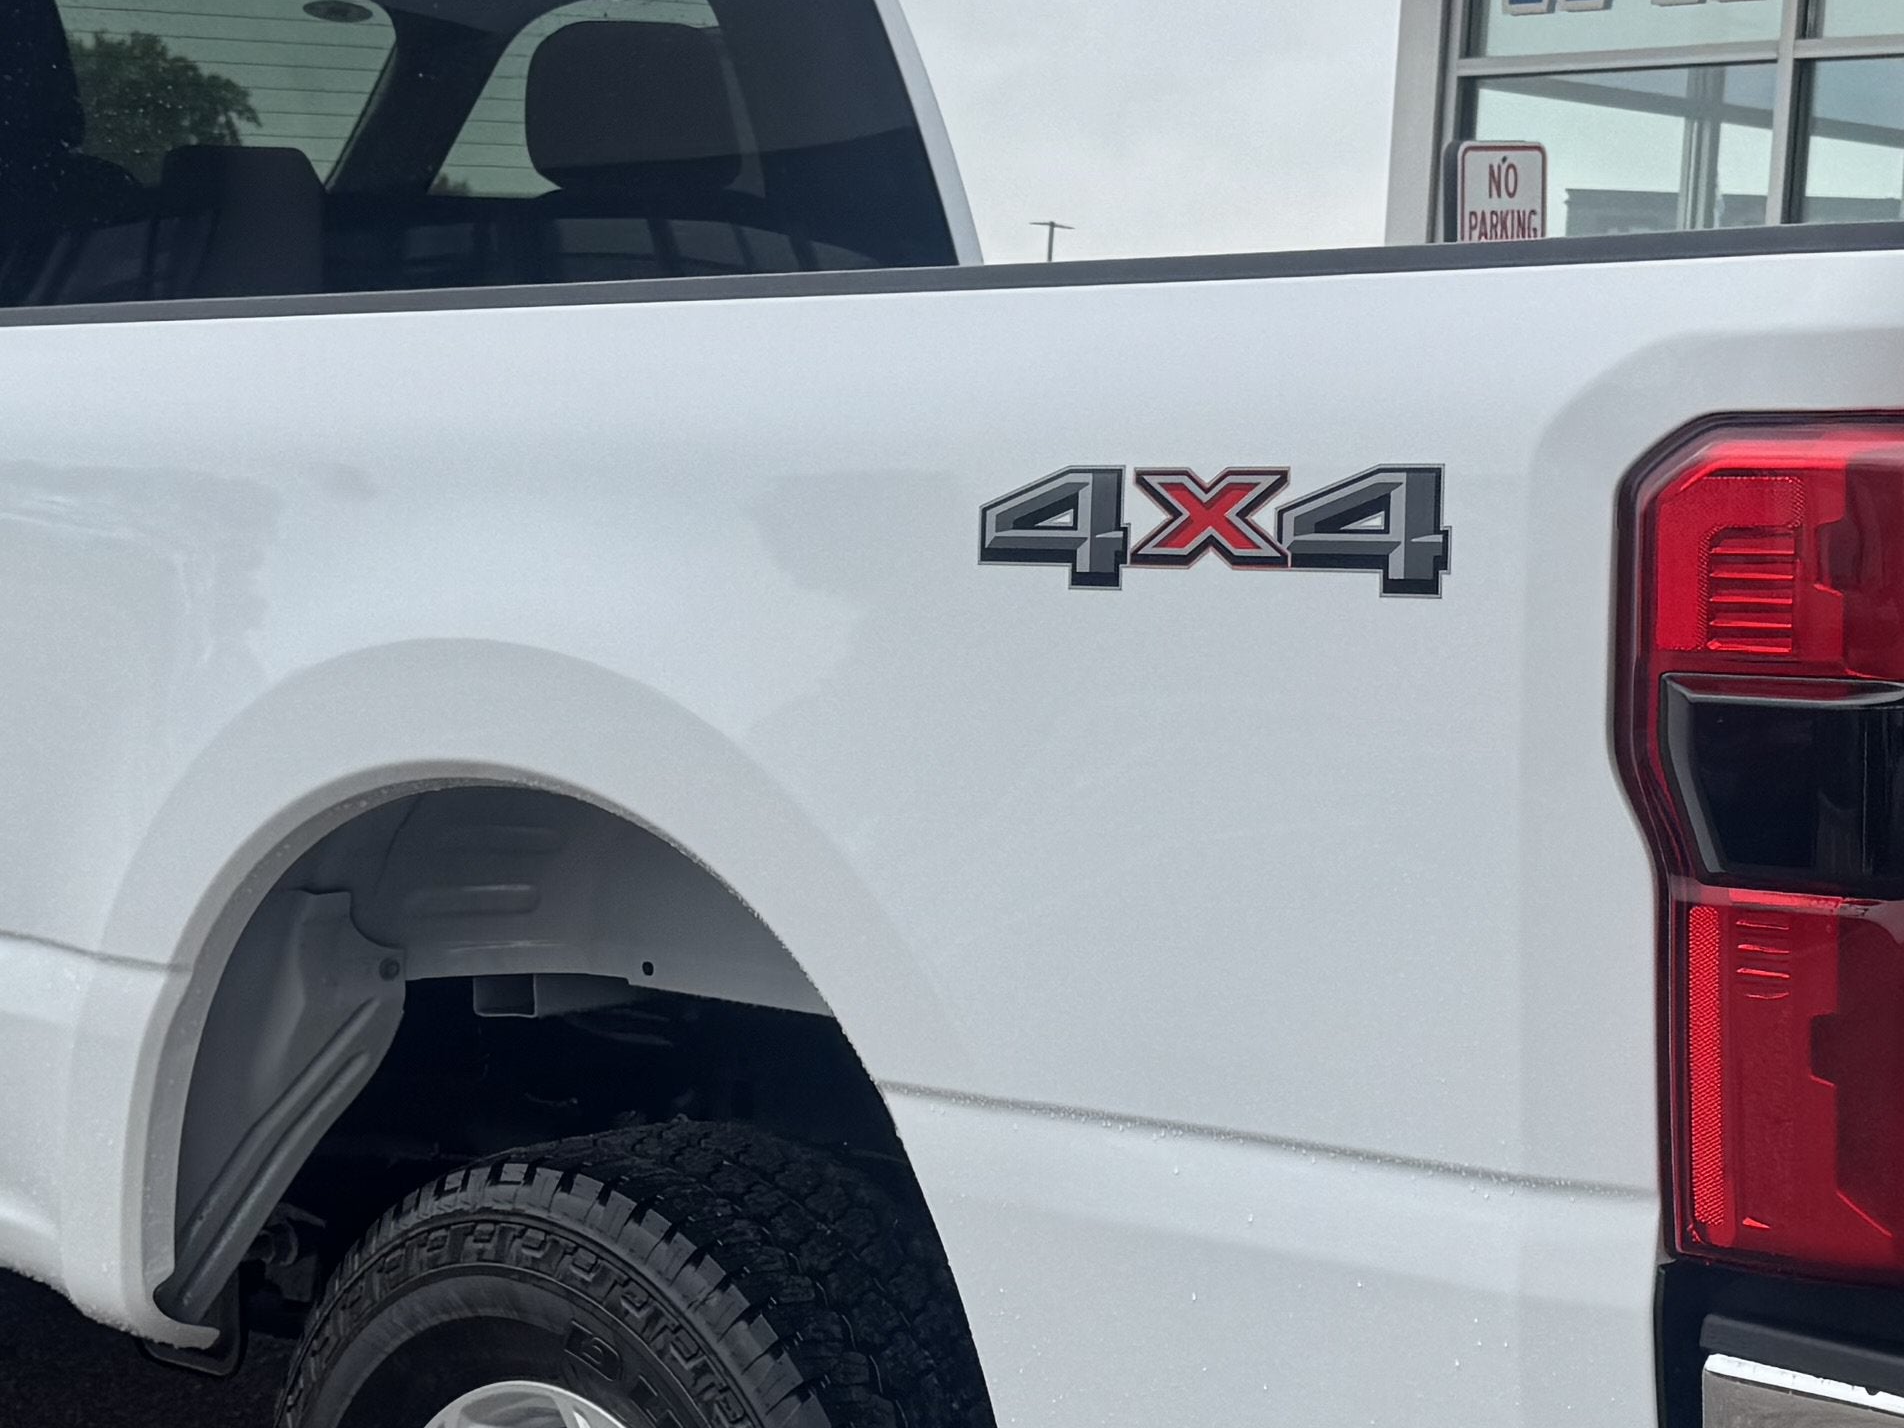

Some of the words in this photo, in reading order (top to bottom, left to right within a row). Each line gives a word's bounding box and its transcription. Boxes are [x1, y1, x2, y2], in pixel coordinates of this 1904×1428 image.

[1489, 162, 1518, 198] NO
[1468, 209, 1539, 241] PARKING
[978, 463, 1452, 598] 4X4
